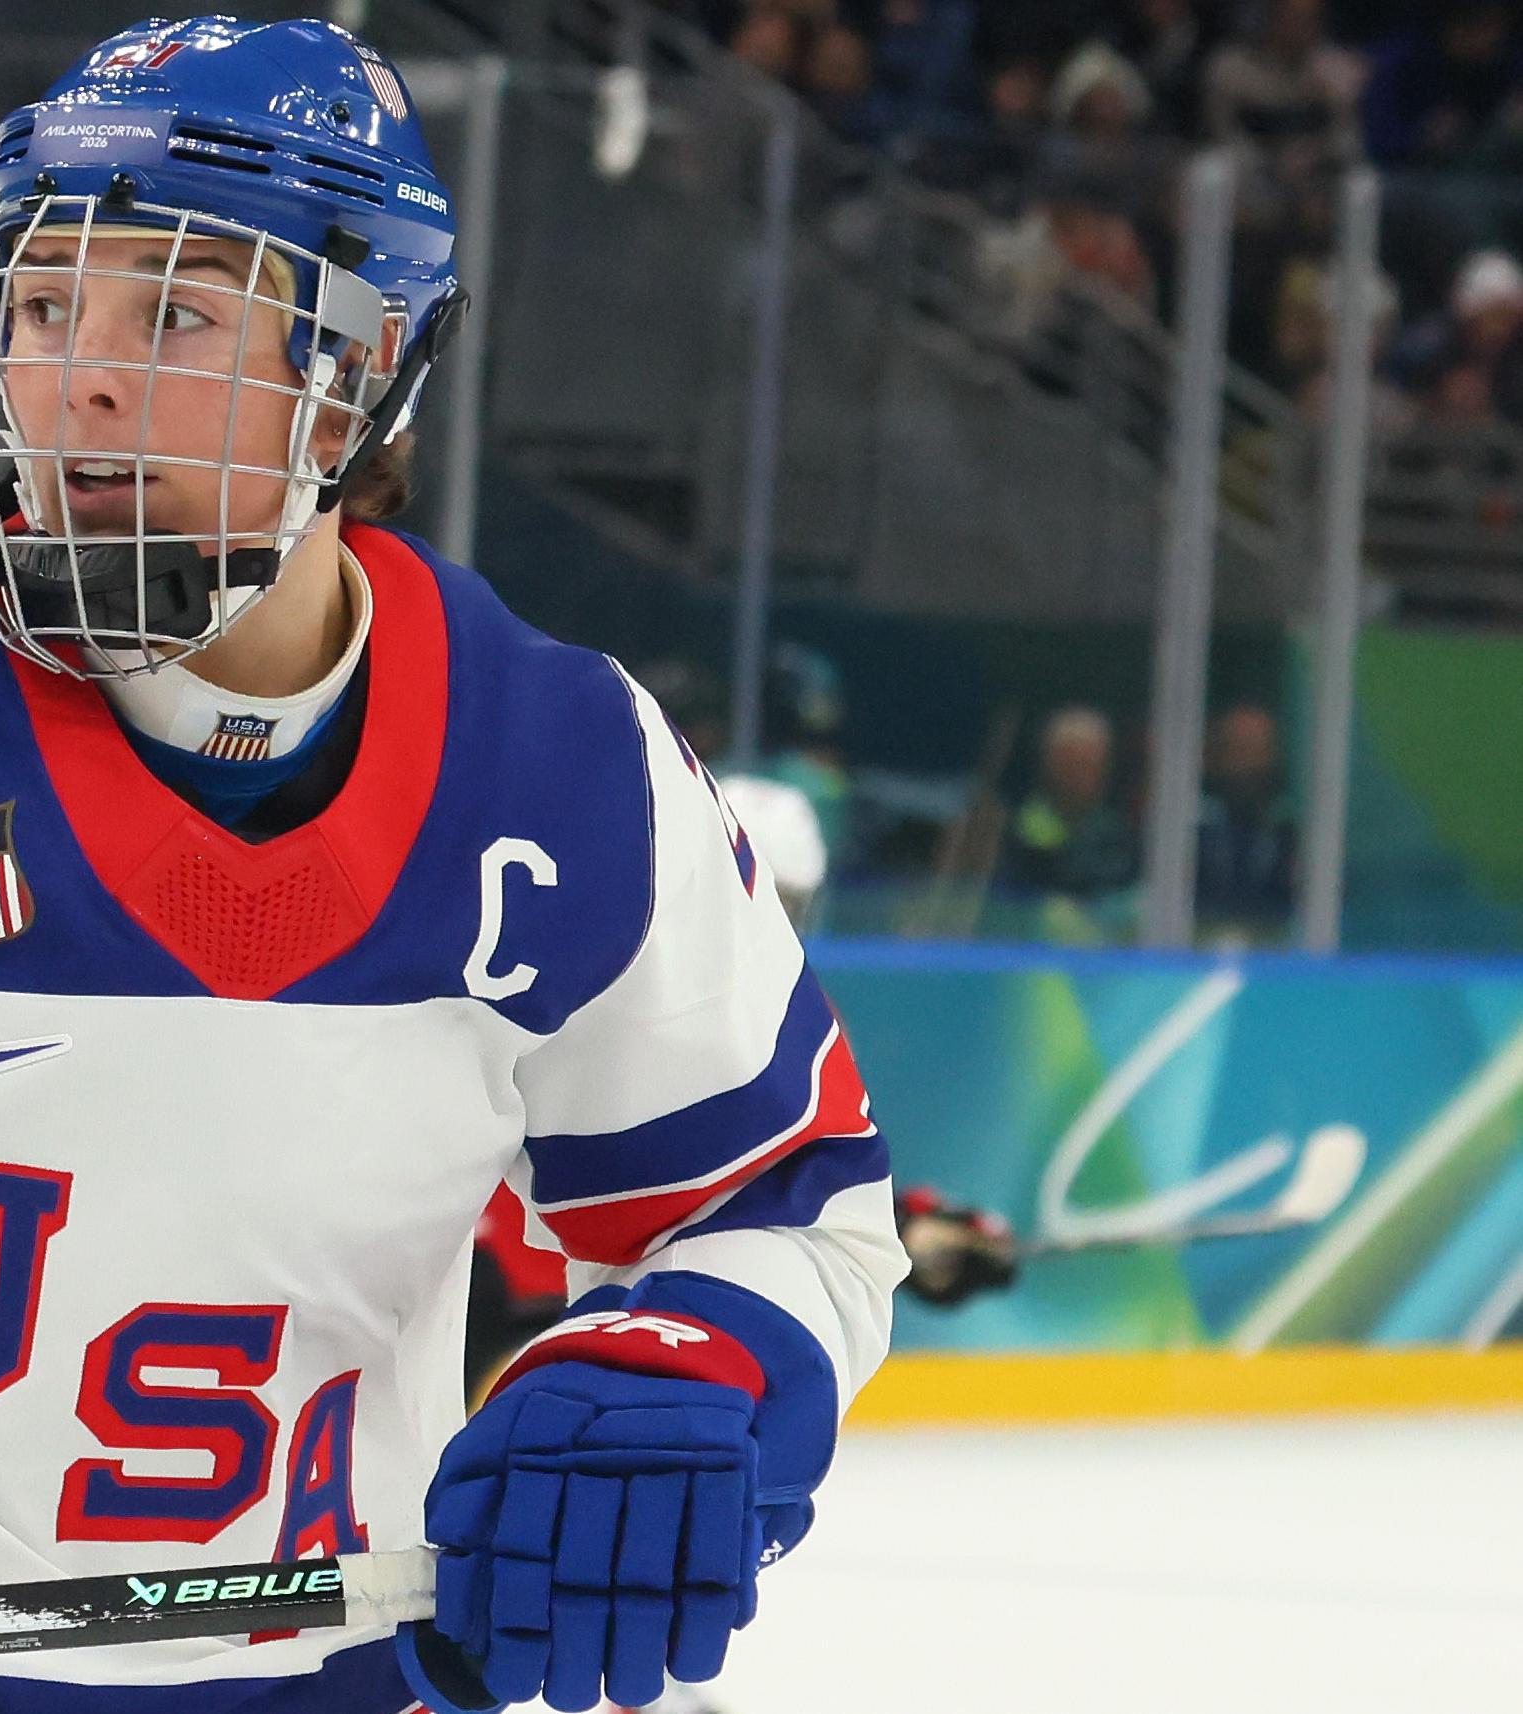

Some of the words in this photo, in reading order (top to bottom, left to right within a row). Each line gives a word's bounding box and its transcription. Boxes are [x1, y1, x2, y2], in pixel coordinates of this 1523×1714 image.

[40, 124, 96, 137] MILANO
[97, 124, 158, 139] CORTINA
[79, 136, 109, 148] 2026
[397, 182, 448, 216] BAUER
[225, 718, 267, 732] USA
[462, 837, 558, 1001] C
[173, 1569, 344, 1604] BAUE
